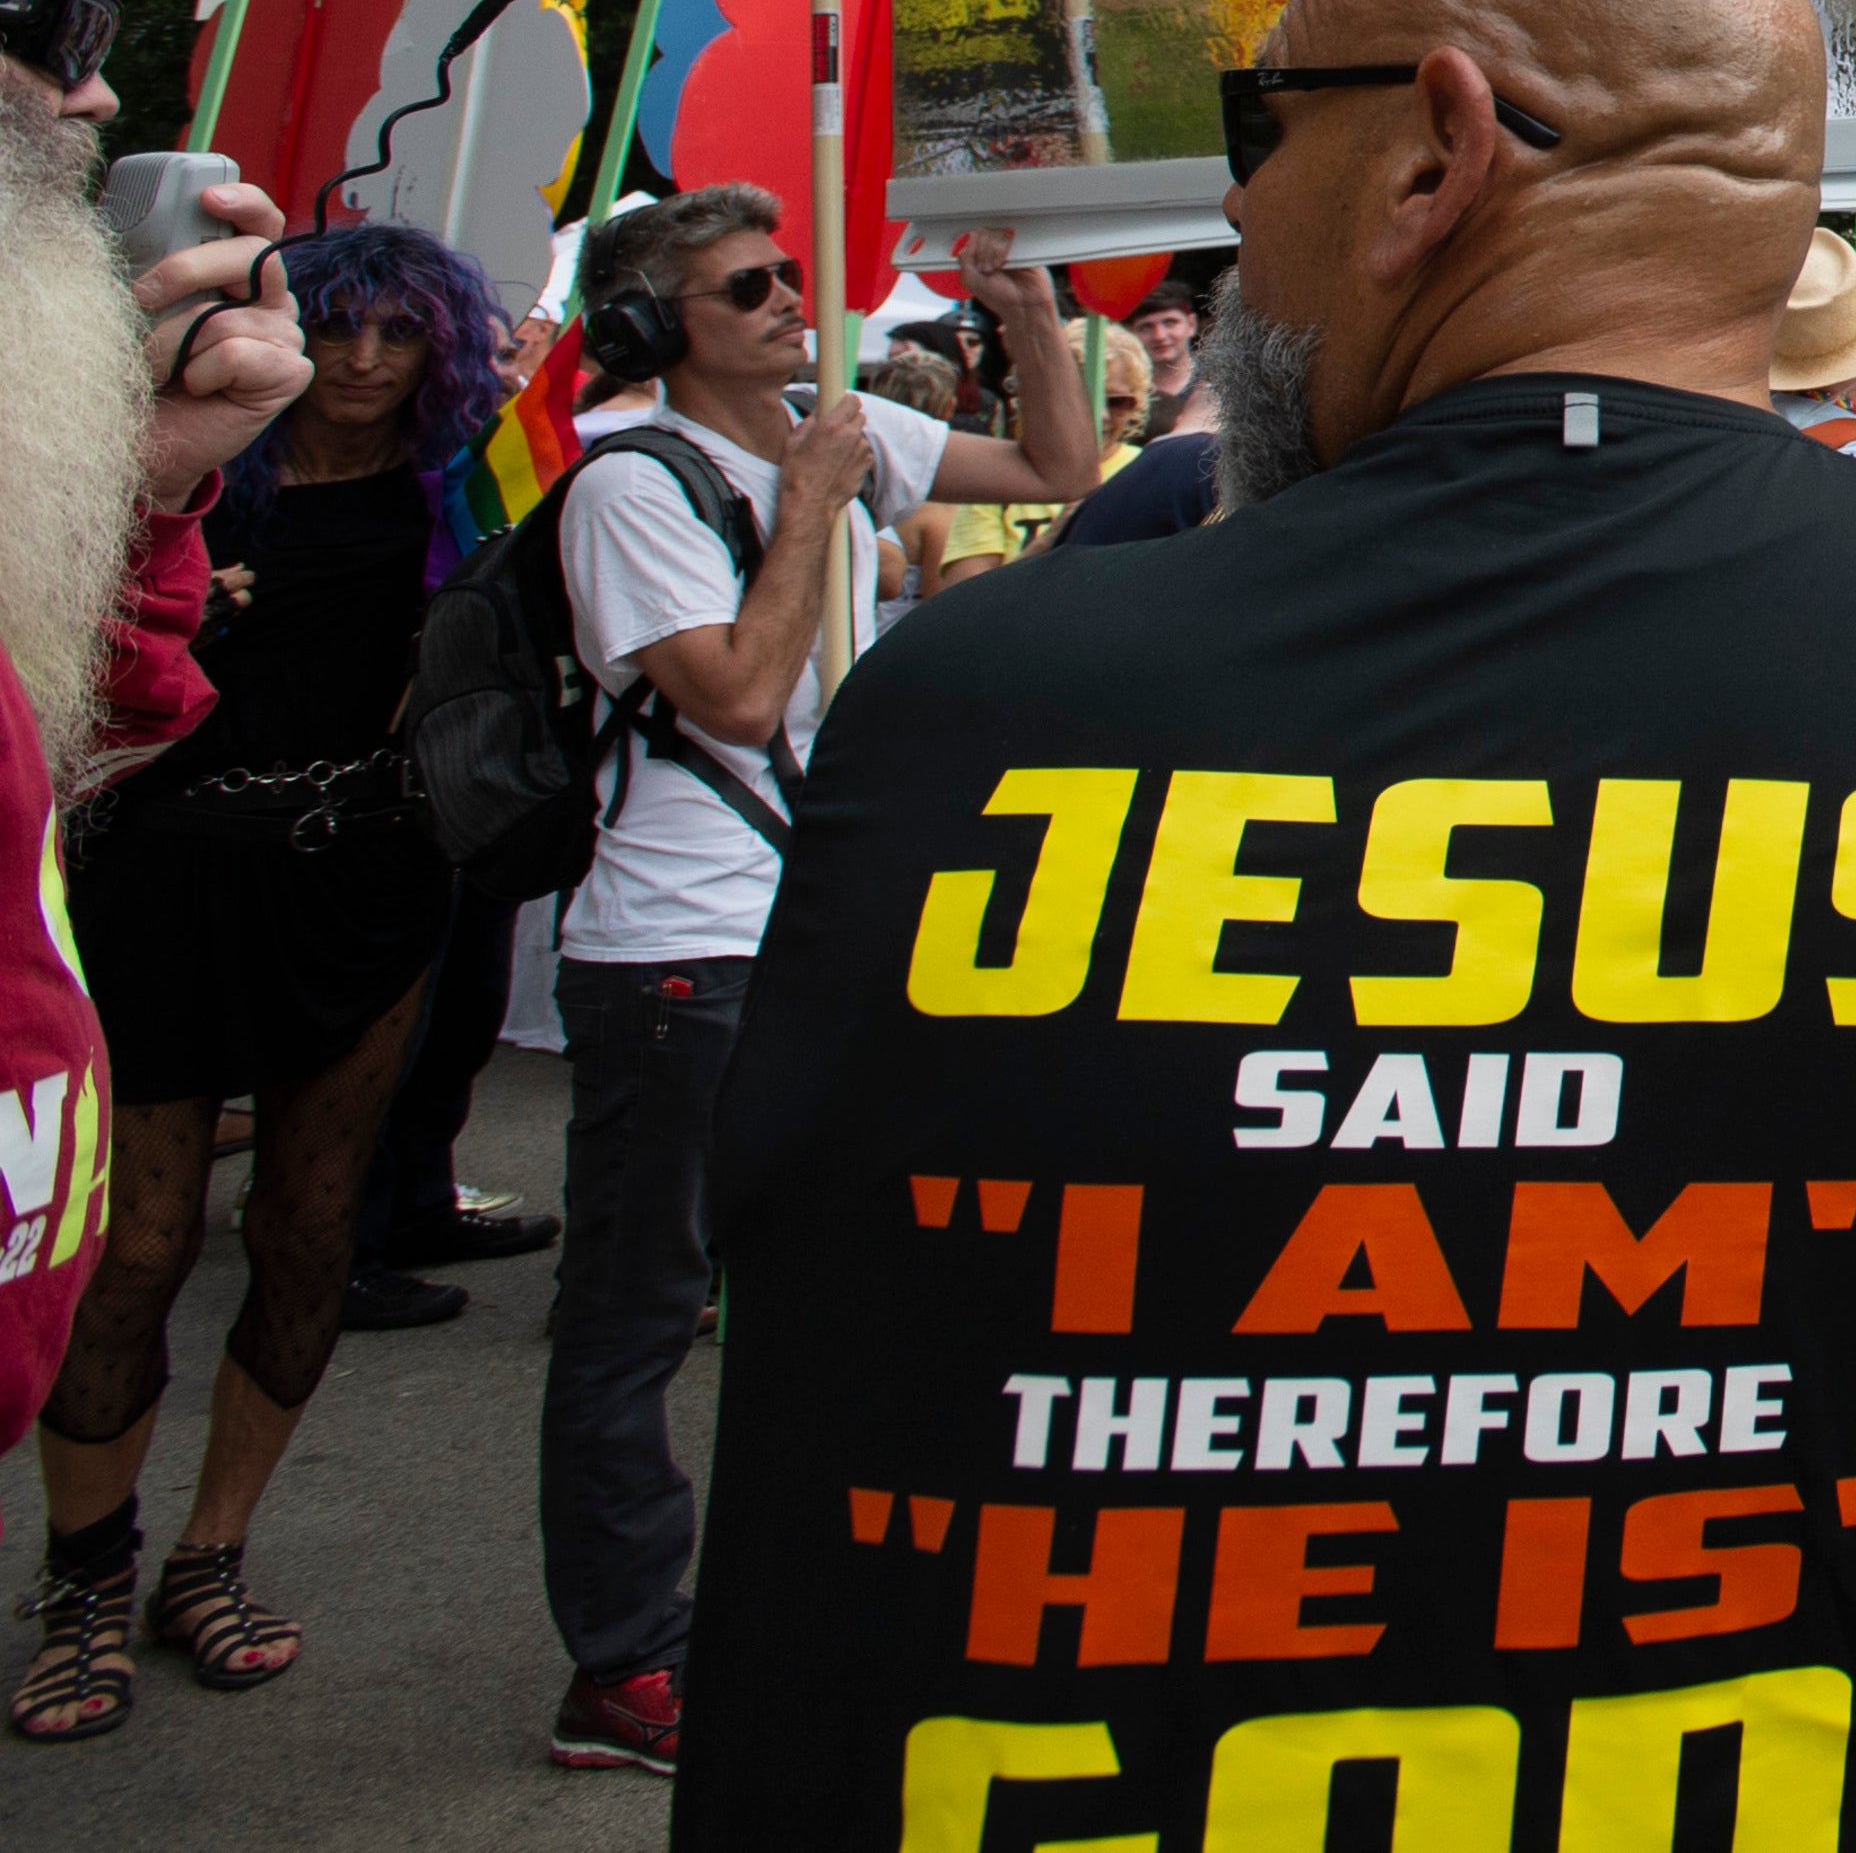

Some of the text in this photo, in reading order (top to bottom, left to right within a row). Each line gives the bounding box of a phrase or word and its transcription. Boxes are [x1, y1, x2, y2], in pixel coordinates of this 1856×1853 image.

[1233, 1049, 1625, 1150] SAID
[1001, 1362, 1794, 1472] THEREFORE
[899, 1663, 1855, 1853] GOD
